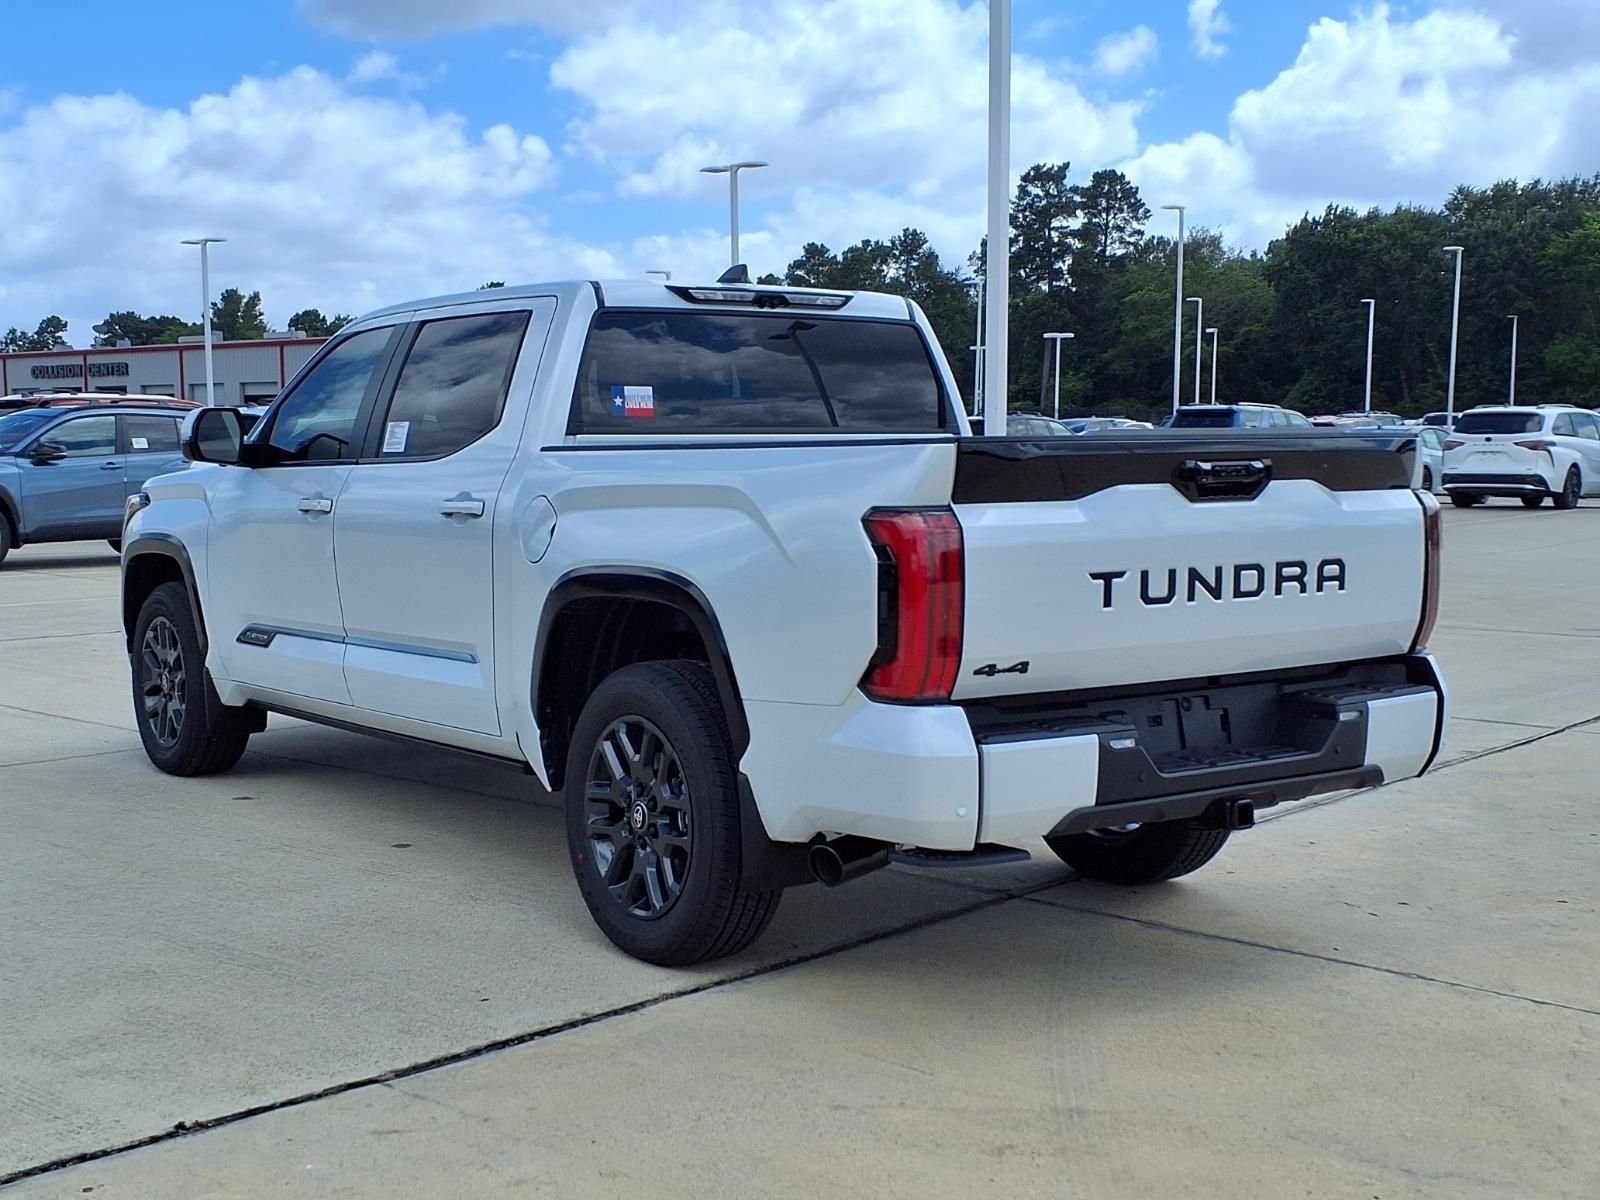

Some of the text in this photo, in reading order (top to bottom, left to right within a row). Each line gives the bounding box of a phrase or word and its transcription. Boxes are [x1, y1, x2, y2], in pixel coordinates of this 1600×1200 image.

[31, 362, 129, 379] COLLISION CENTER
[1088, 557, 1346, 609] TUNDRA
